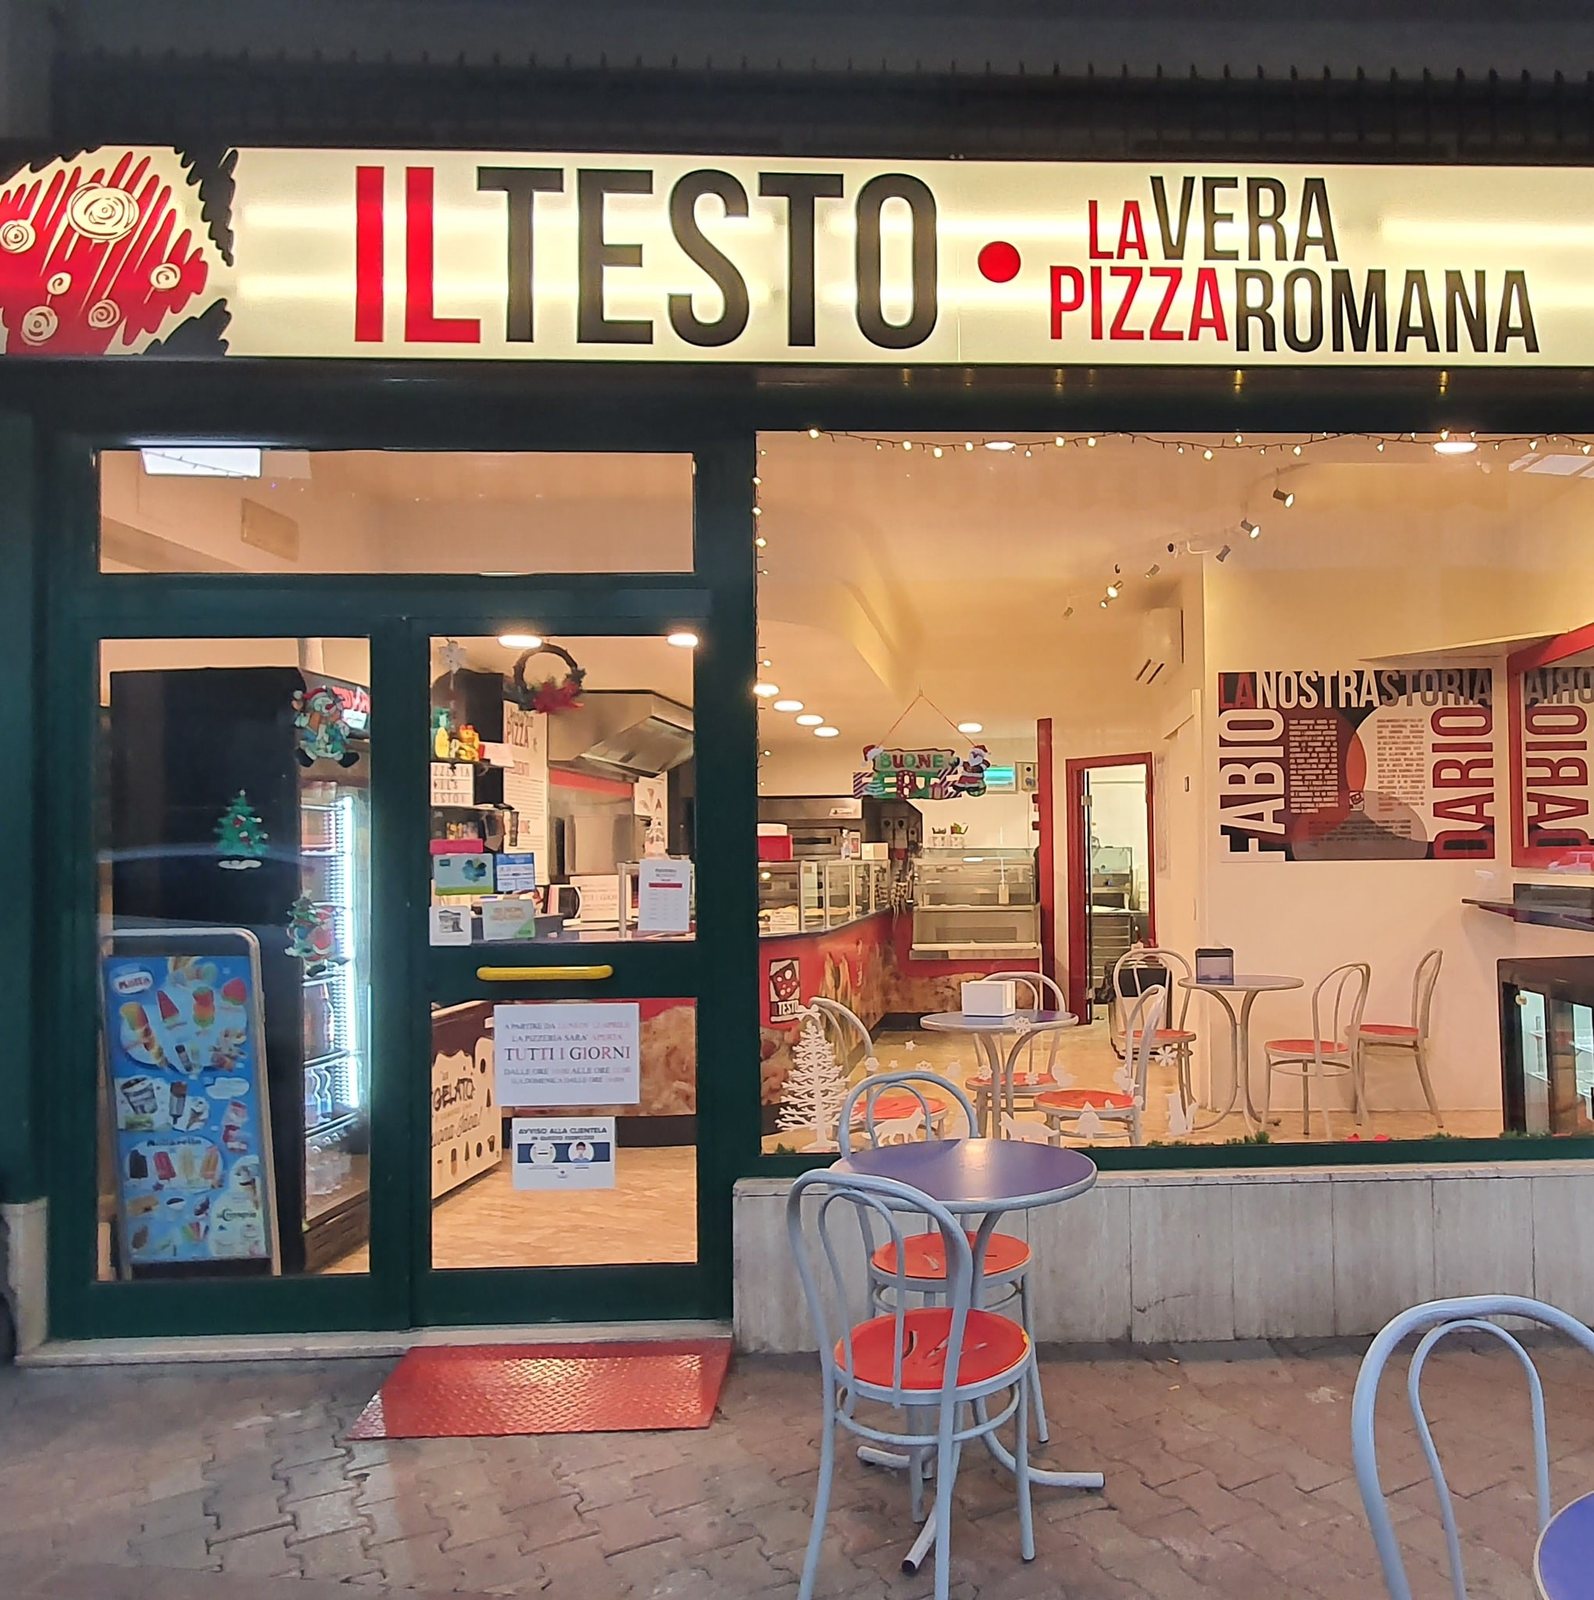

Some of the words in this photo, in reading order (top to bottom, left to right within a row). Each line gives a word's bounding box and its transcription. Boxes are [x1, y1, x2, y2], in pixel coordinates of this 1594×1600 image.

[880, 754, 945, 769] BUONE
[1218, 707, 1287, 862] FABIO
[1430, 706, 1496, 860] DARIO
[525, 1034, 562, 1042] PIZZERIA
[504, 1047, 554, 1061] TUTTI
[559, 1047, 564, 1060] I
[569, 1046, 630, 1061] GIORNI
[504, 1068, 530, 1076] DALLE
[433, 1077, 476, 1112] GELATO
